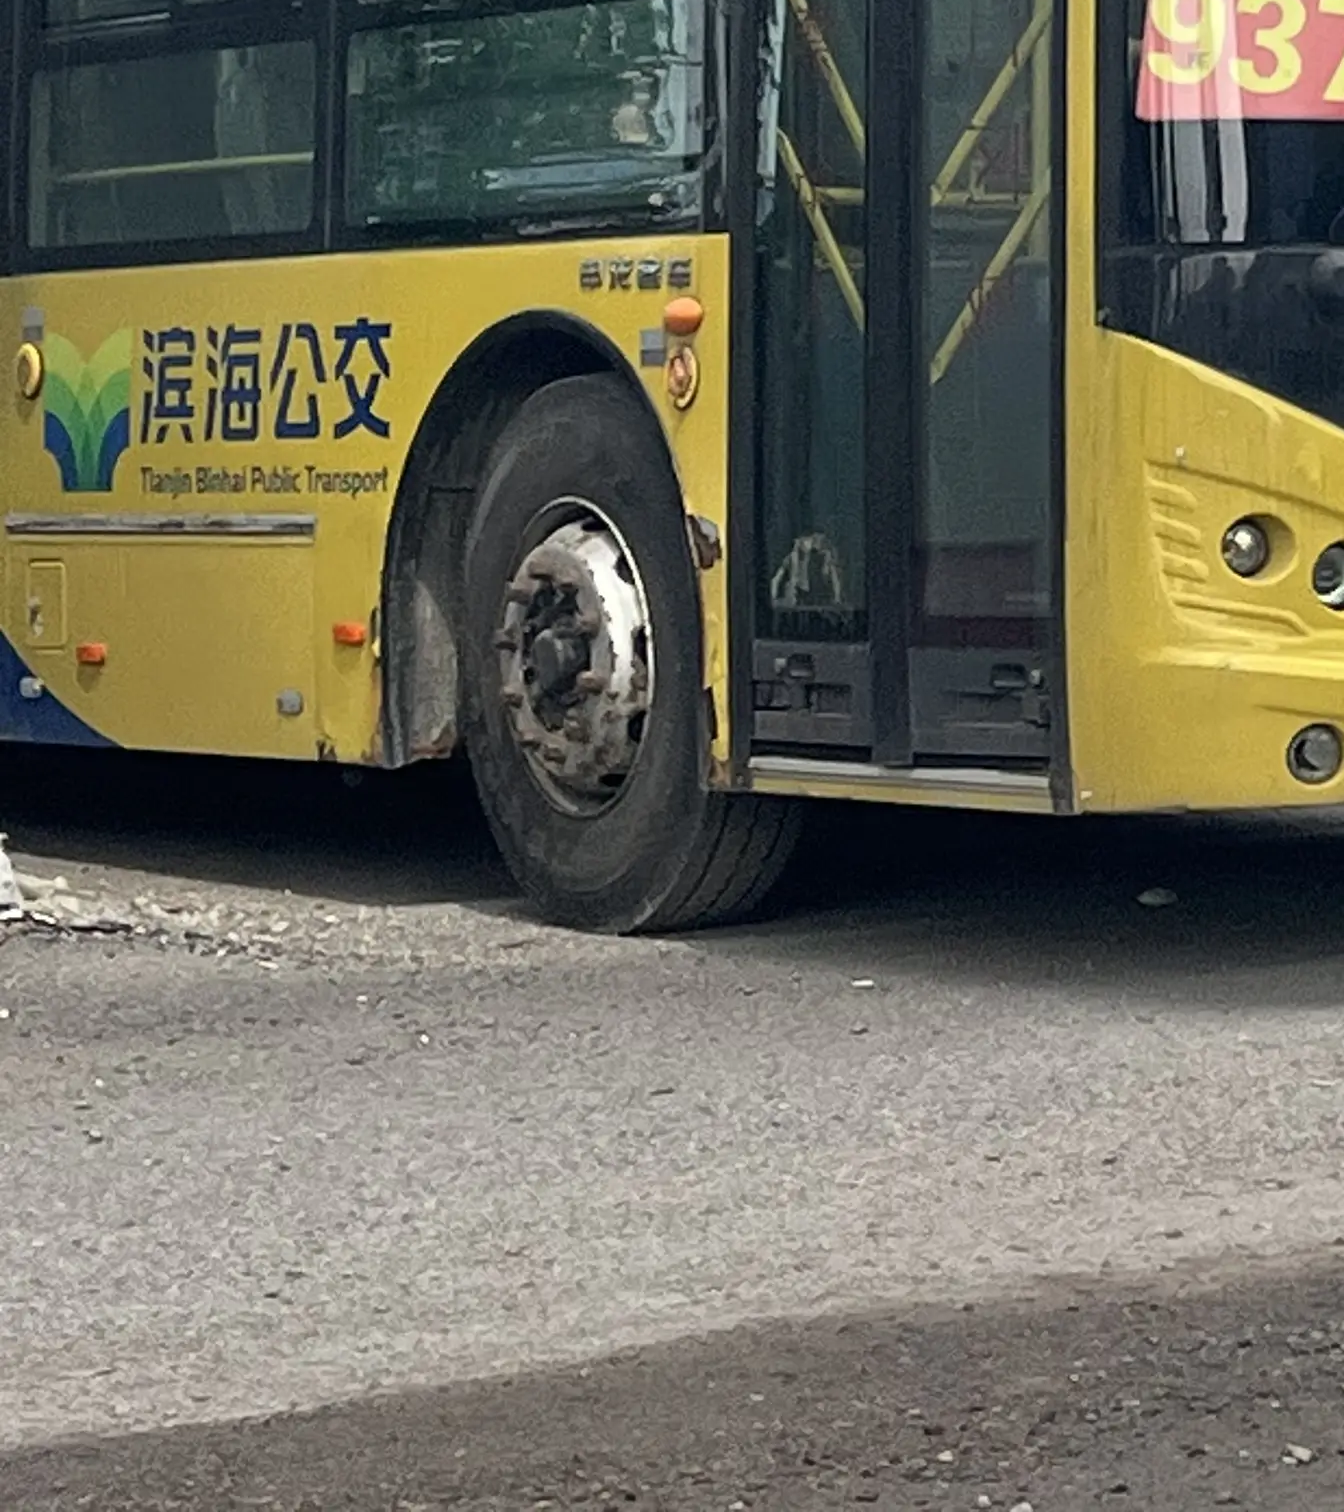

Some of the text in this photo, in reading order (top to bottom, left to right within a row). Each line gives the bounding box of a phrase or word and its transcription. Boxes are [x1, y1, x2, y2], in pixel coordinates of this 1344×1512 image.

[140, 317, 392, 444] 滨海公交
[140, 465, 389, 500] Tianjin Binhai Public Transport
